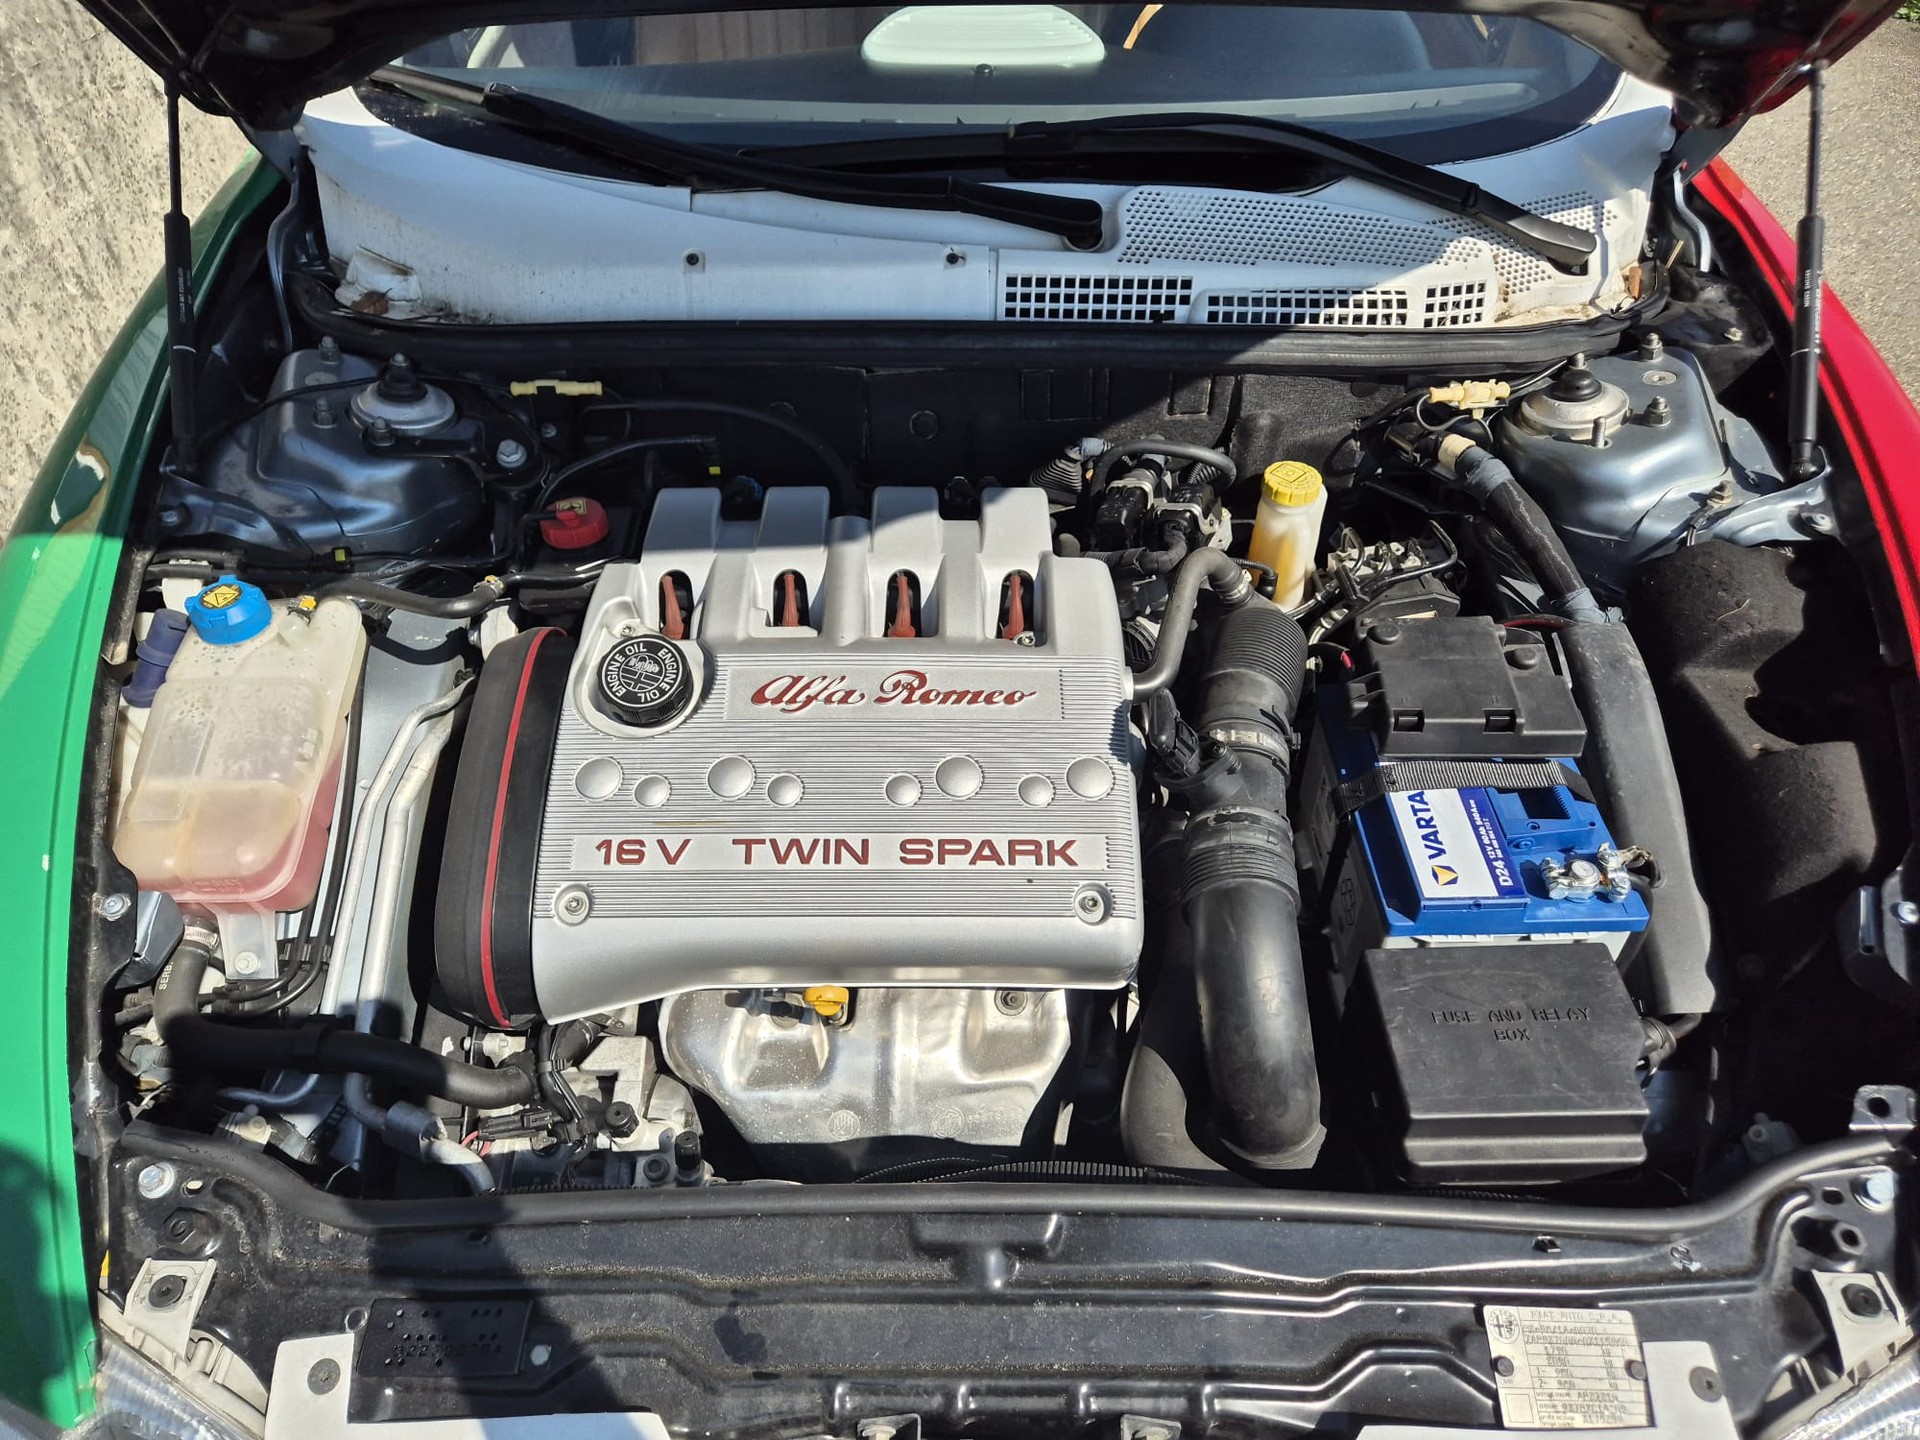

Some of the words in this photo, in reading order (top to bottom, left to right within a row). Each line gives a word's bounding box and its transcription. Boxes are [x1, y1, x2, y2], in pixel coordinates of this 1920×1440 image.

[607, 653, 627, 698] ENGINE
[625, 642, 648, 656] OIL
[657, 647, 677, 692] ENGINE
[637, 689, 660, 703] OIL
[751, 674, 866, 714] Alfa
[873, 669, 1037, 706] Romeo
[1407, 790, 1447, 860] VARTA
[1478, 826, 1492, 845] 60Ah
[732, 838, 870, 866] TWIN
[899, 838, 1079, 867] SPARK
[1485, 845, 1497, 859] 12V
[1492, 860, 1514, 886] D24
[1431, 1010, 1481, 1025] FUSE
[1488, 1009, 1522, 1023] AND
[1531, 1007, 1590, 1022] RELAY
[1494, 1028, 1532, 1042] BOX
